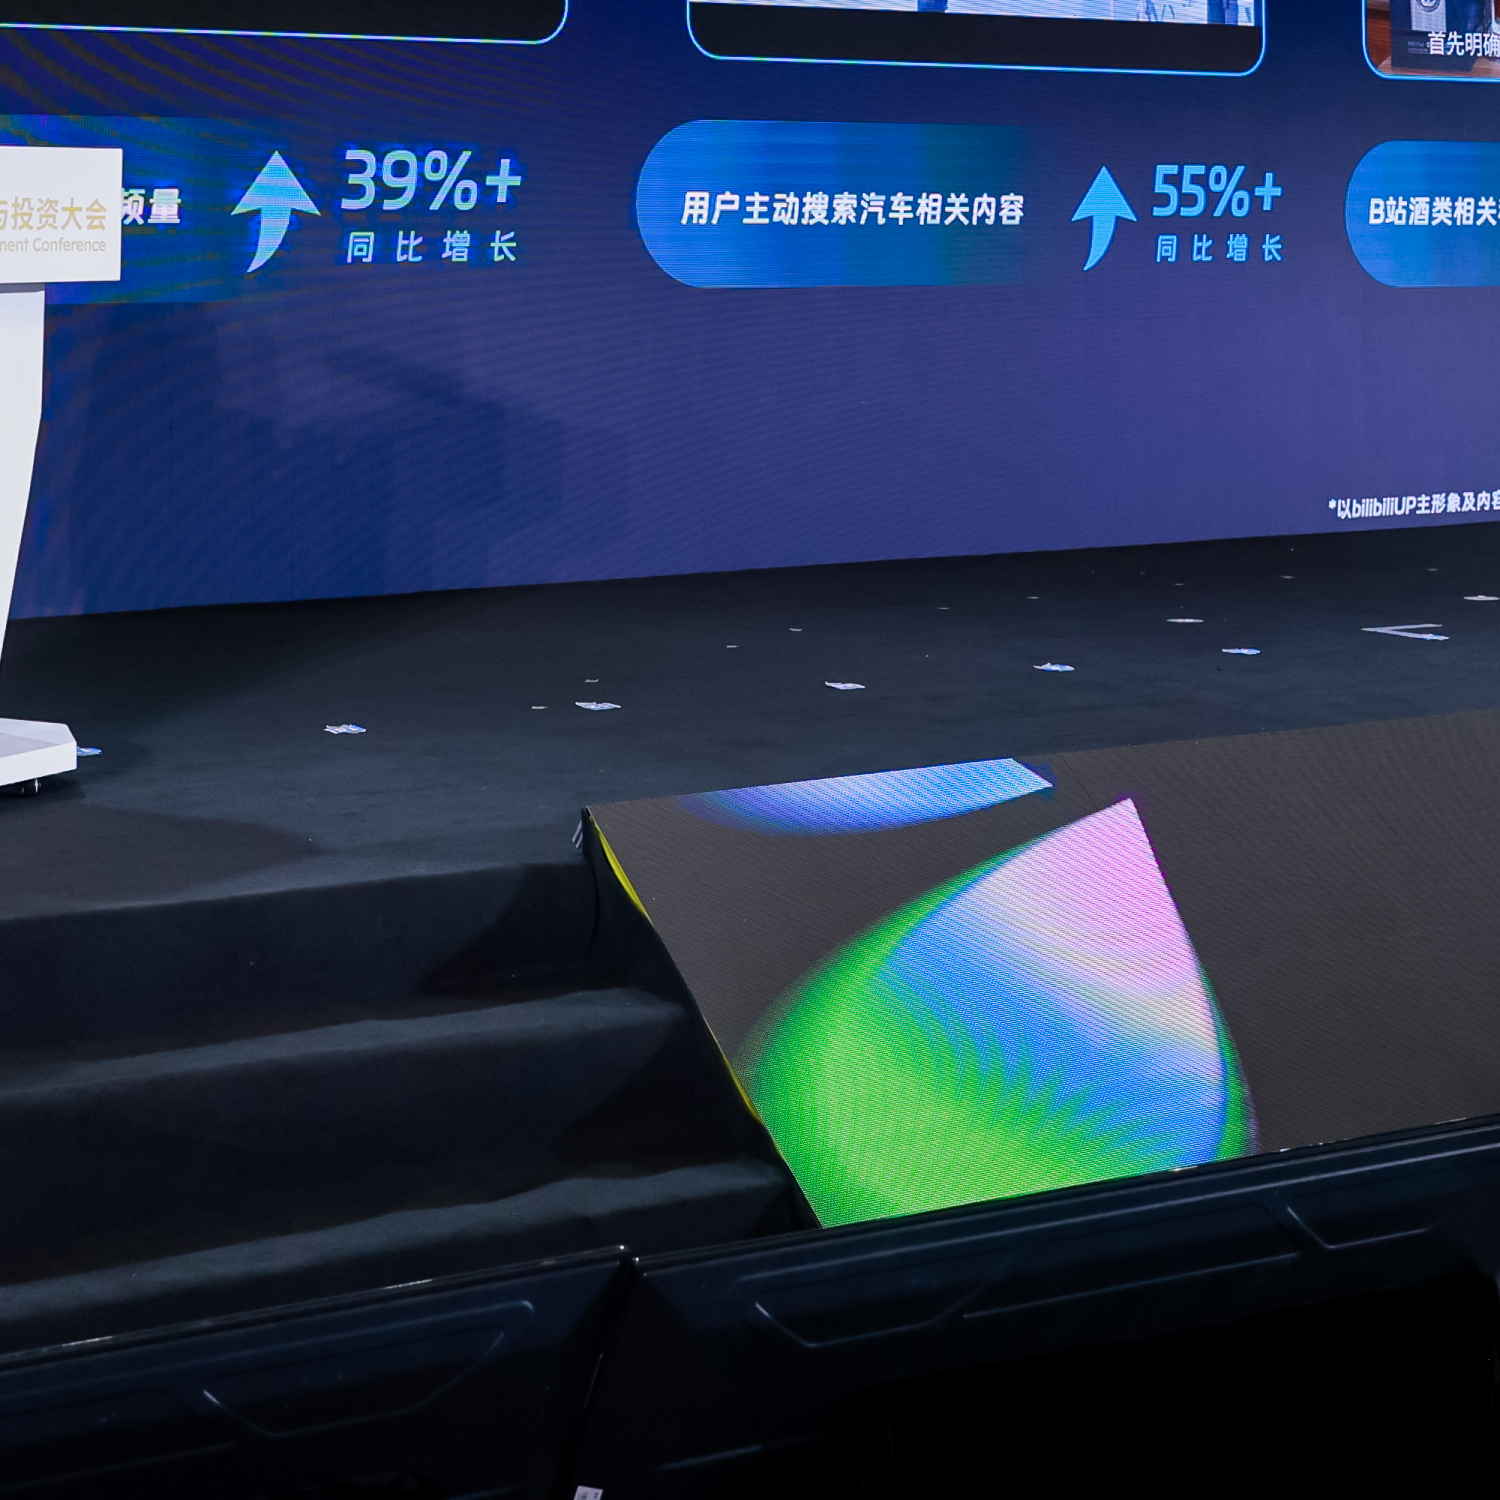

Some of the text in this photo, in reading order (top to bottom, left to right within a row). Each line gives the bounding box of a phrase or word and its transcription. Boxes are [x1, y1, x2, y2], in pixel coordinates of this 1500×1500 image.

[340, 149, 522, 211] 39%+
[1152, 163, 1284, 218] 55%+
[680, 190, 1025, 227] 用户主动搜索汽车相关内容
[32, 237, 107, 252] Conference
[346, 229, 517, 264] 同比增长
[1156, 233, 1283, 263] 同比增长
